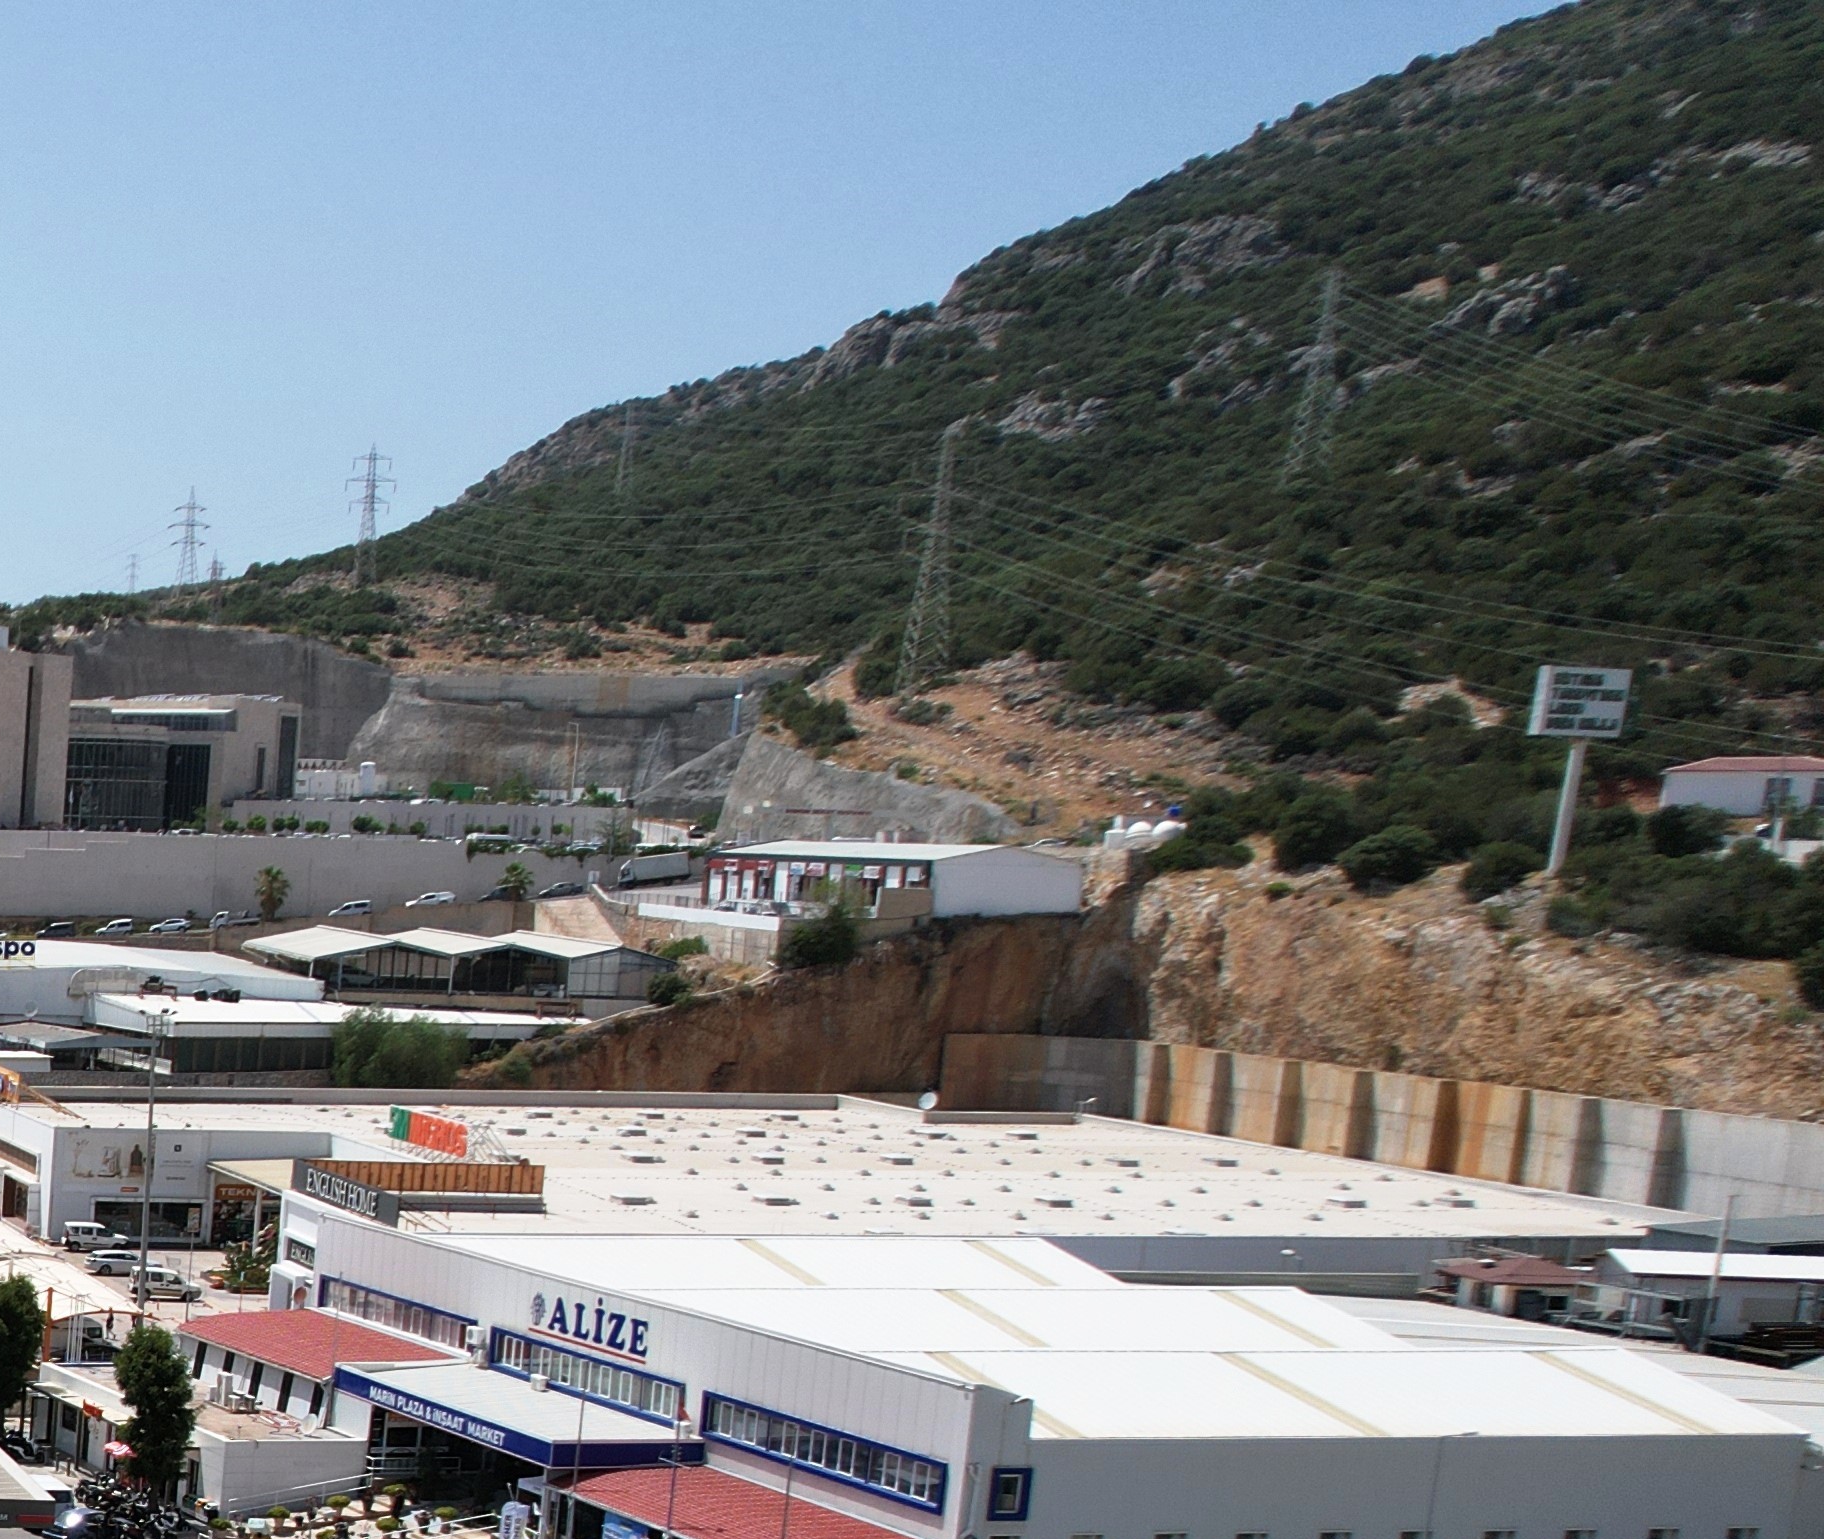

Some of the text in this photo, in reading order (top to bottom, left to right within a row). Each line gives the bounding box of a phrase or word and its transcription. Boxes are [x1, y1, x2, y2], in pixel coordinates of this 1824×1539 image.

[307, 1168, 378, 1217] ENGLISH HOME
[547, 1296, 649, 1357] ALİZE
[397, 1395, 424, 1418] PLAZA
[425, 1405, 432, 1420] &
[467, 1421, 506, 1447] MARKET
